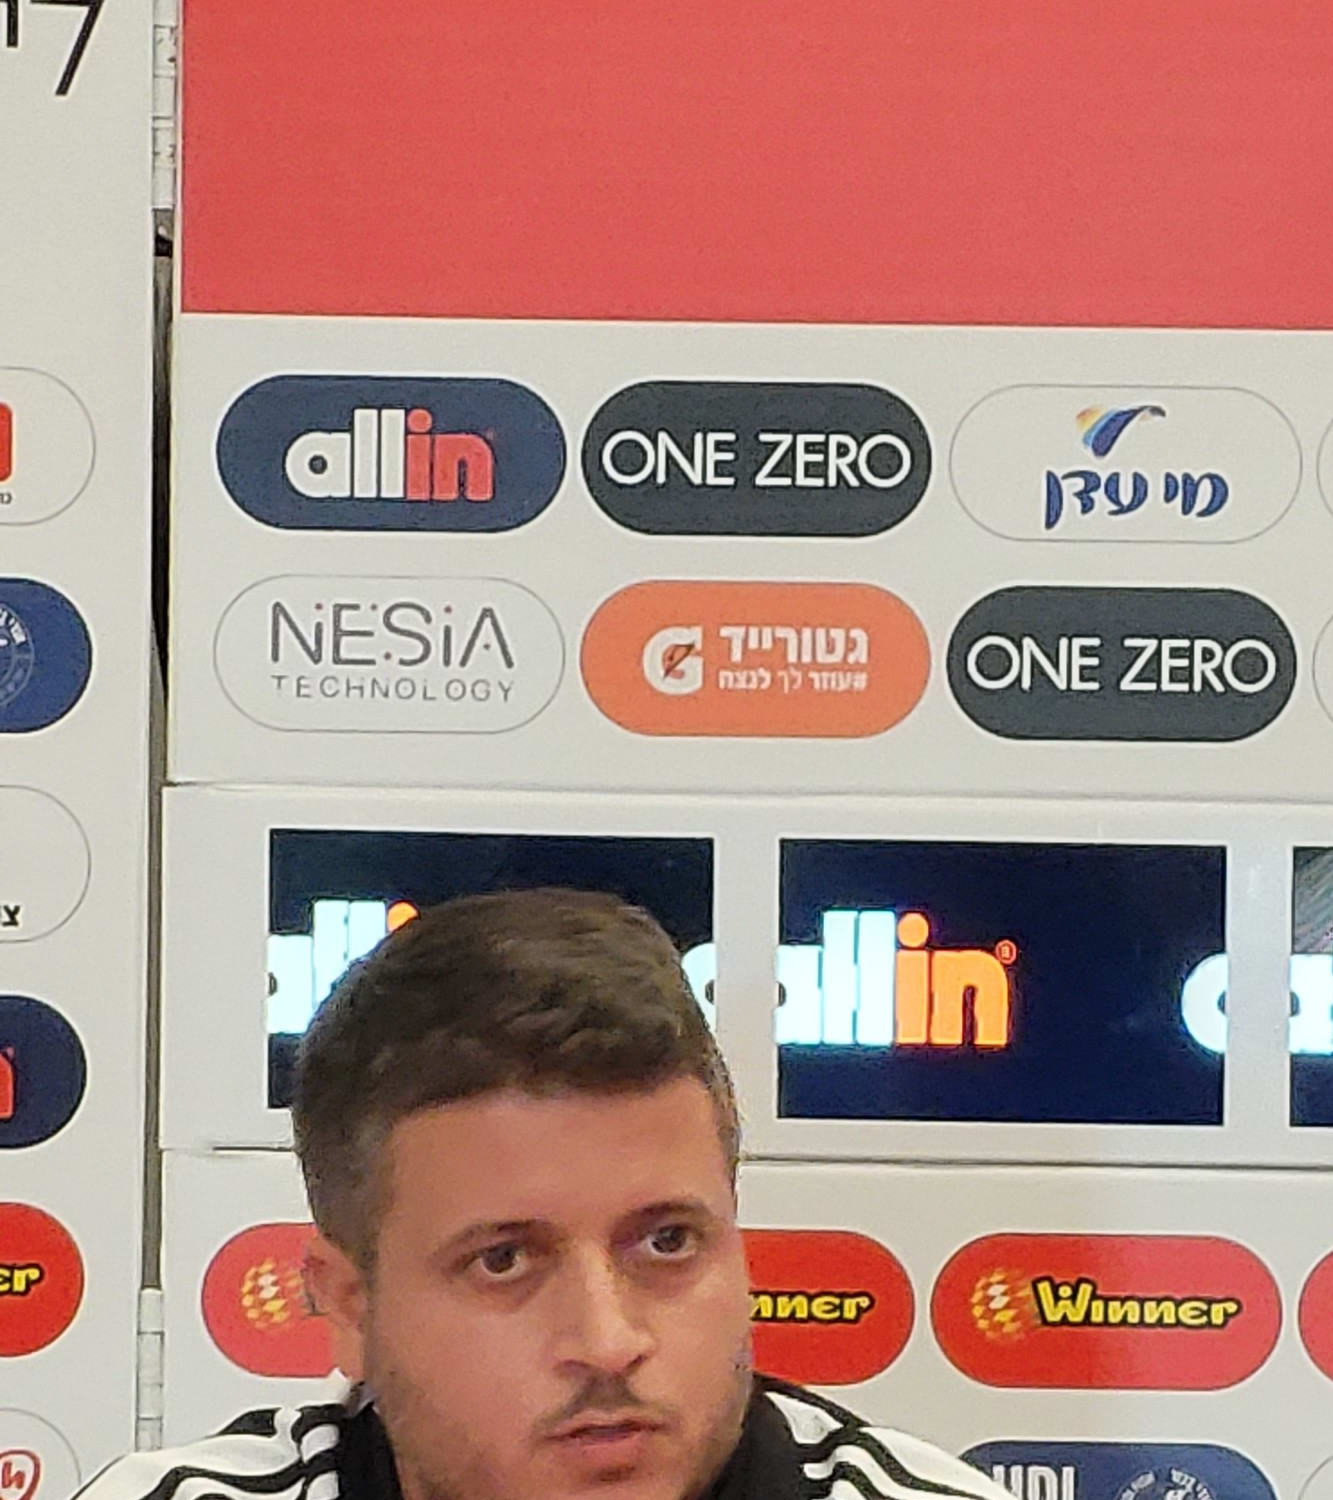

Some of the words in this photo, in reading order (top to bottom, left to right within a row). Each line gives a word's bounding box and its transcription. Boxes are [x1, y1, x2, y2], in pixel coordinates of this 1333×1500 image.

[286, 407, 495, 503] allin
[603, 431, 735, 485] ONE
[755, 430, 910, 487] ZERO
[1045, 470, 1148, 530] עדן
[1164, 472, 1228, 517] מי
[720, 626, 868, 664] גטורייד
[965, 632, 1100, 690] ONE
[1120, 637, 1276, 693] ZERO
[271, 675, 511, 702] TECHNOLOGY
[719, 668, 771, 689] לנצח
[777, 666, 805, 693] לך
[1030, 1276, 1242, 1329] Winner
